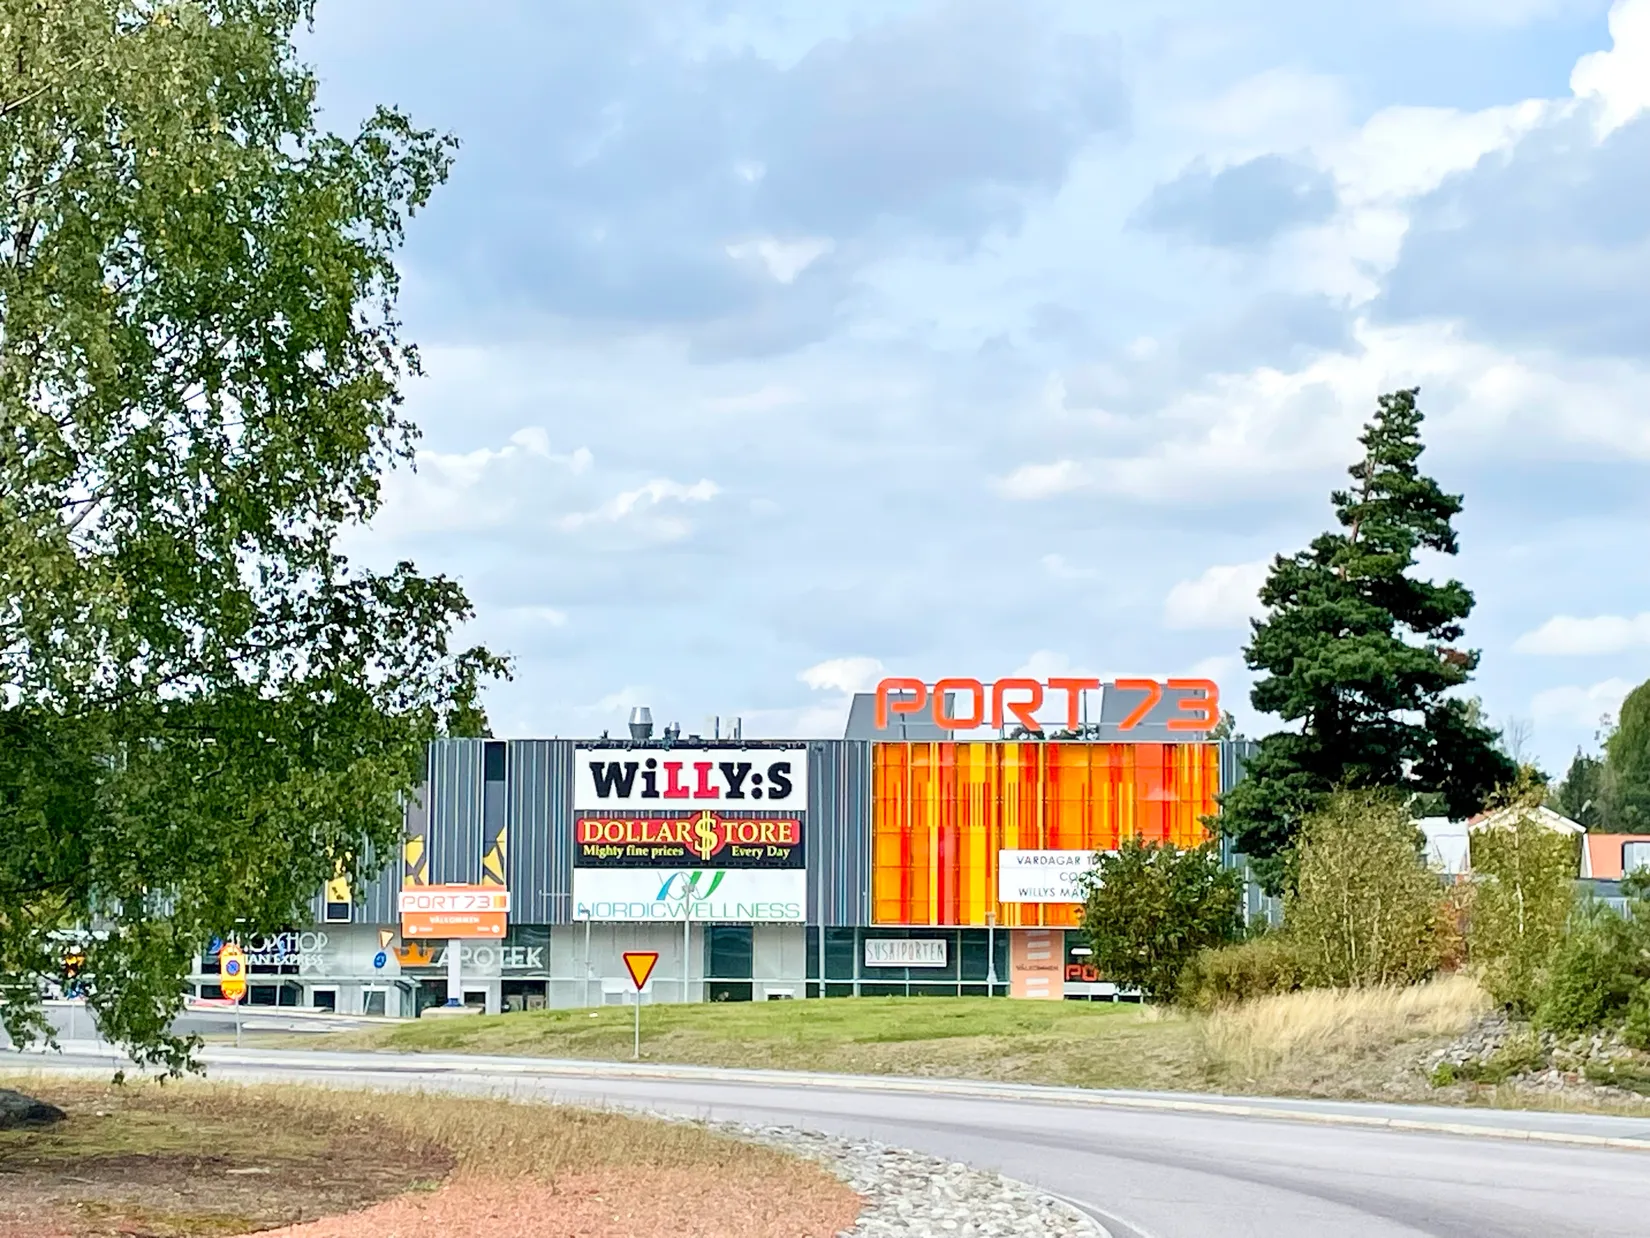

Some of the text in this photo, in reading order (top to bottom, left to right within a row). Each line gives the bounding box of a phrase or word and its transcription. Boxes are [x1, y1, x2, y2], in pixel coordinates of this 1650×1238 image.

[876, 678, 1220, 731] PORT 73
[583, 845, 684, 858] Mighty fine prices
[732, 846, 790, 859] Every Day
[1016, 856, 1081, 865] VARDAGAR
[1018, 887, 1055, 897] WILLYS
[402, 895, 491, 909] PORT 73
[273, 953, 324, 966] EXPRESS
[437, 946, 544, 968] APOTEK
